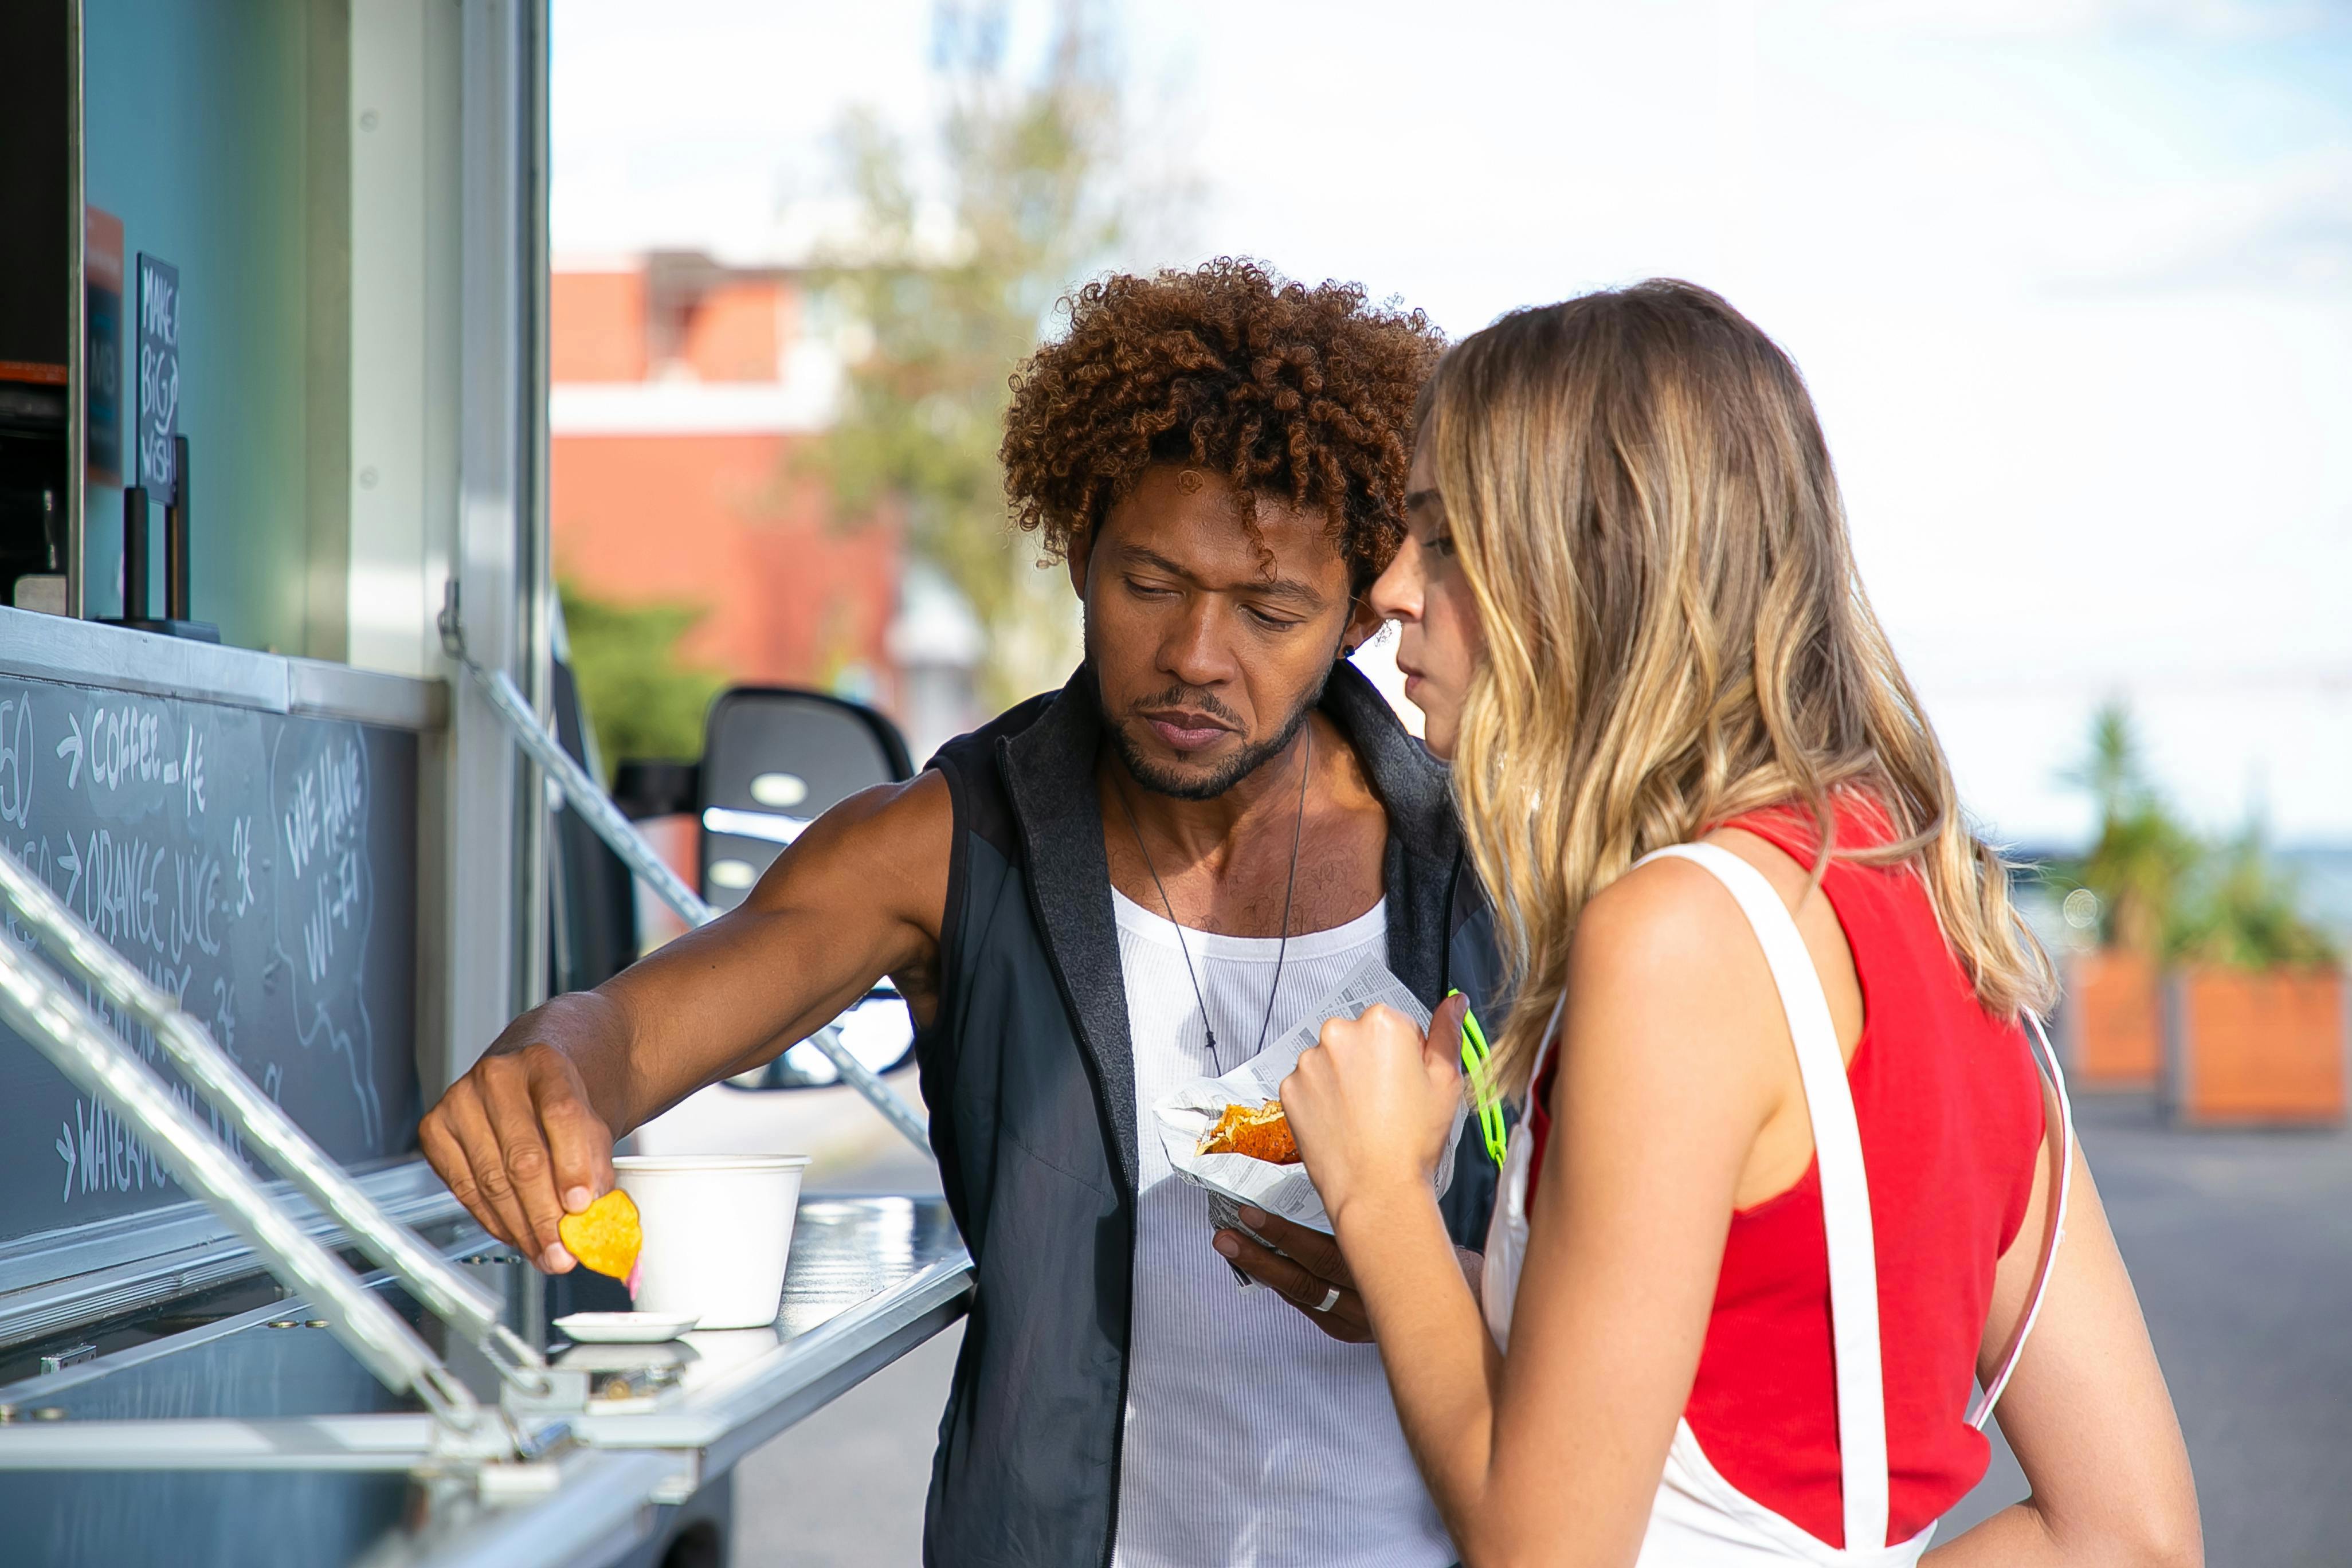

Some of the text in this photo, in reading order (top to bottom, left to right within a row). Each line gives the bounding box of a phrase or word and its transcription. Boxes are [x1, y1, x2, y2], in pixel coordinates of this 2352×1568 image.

[143, 266, 173, 345] MAKE
[91, 706, 160, 791] COFFEE
[285, 739, 361, 879] WE HAVE
[85, 829, 166, 954] ORANGE
